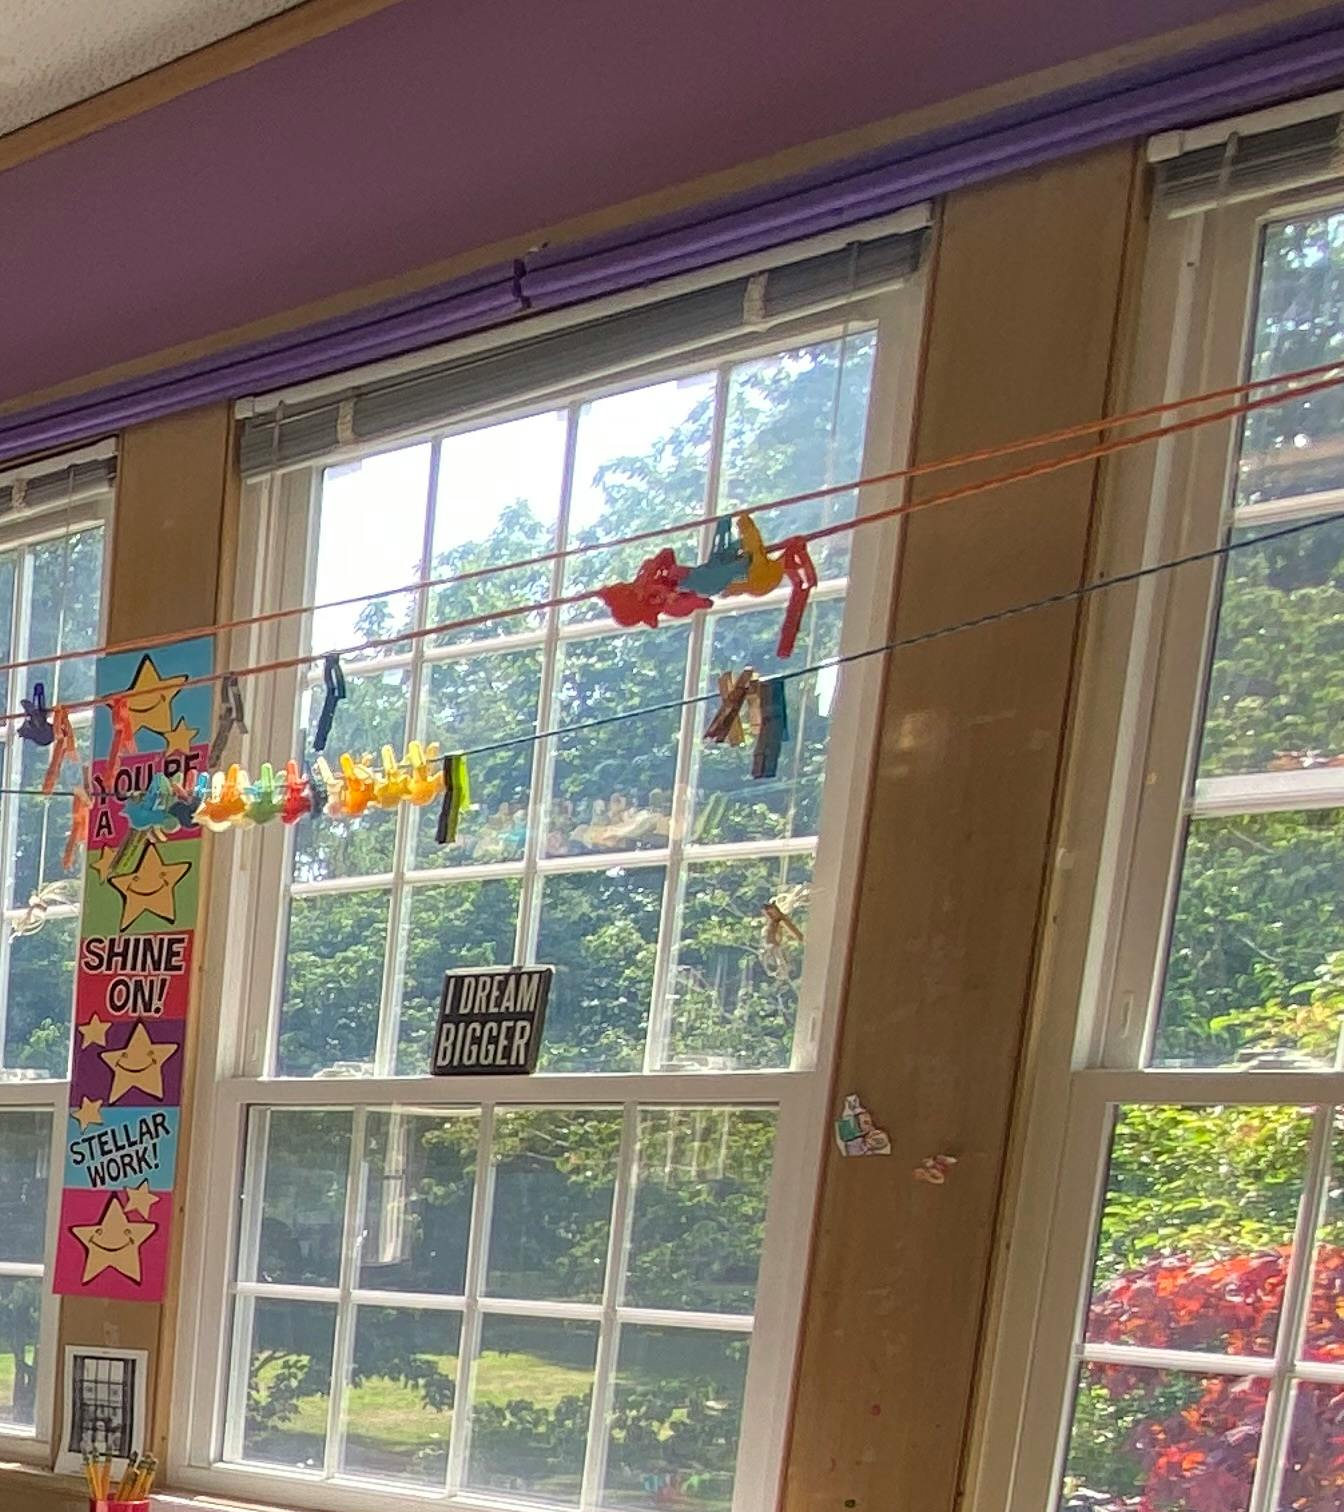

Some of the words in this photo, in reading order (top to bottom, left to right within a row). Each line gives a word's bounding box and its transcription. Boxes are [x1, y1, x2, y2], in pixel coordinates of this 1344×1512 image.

[93, 752, 200, 805] YOURE
[96, 811, 113, 838] A
[83, 936, 186, 973] SHINE
[108, 977, 168, 1015] ON!
[445, 977, 456, 1015] I
[459, 973, 541, 1014] DREAM
[436, 1020, 531, 1067] BIGGER
[70, 1112, 170, 1165] STELLAR
[86, 1142, 160, 1188] WORK!
